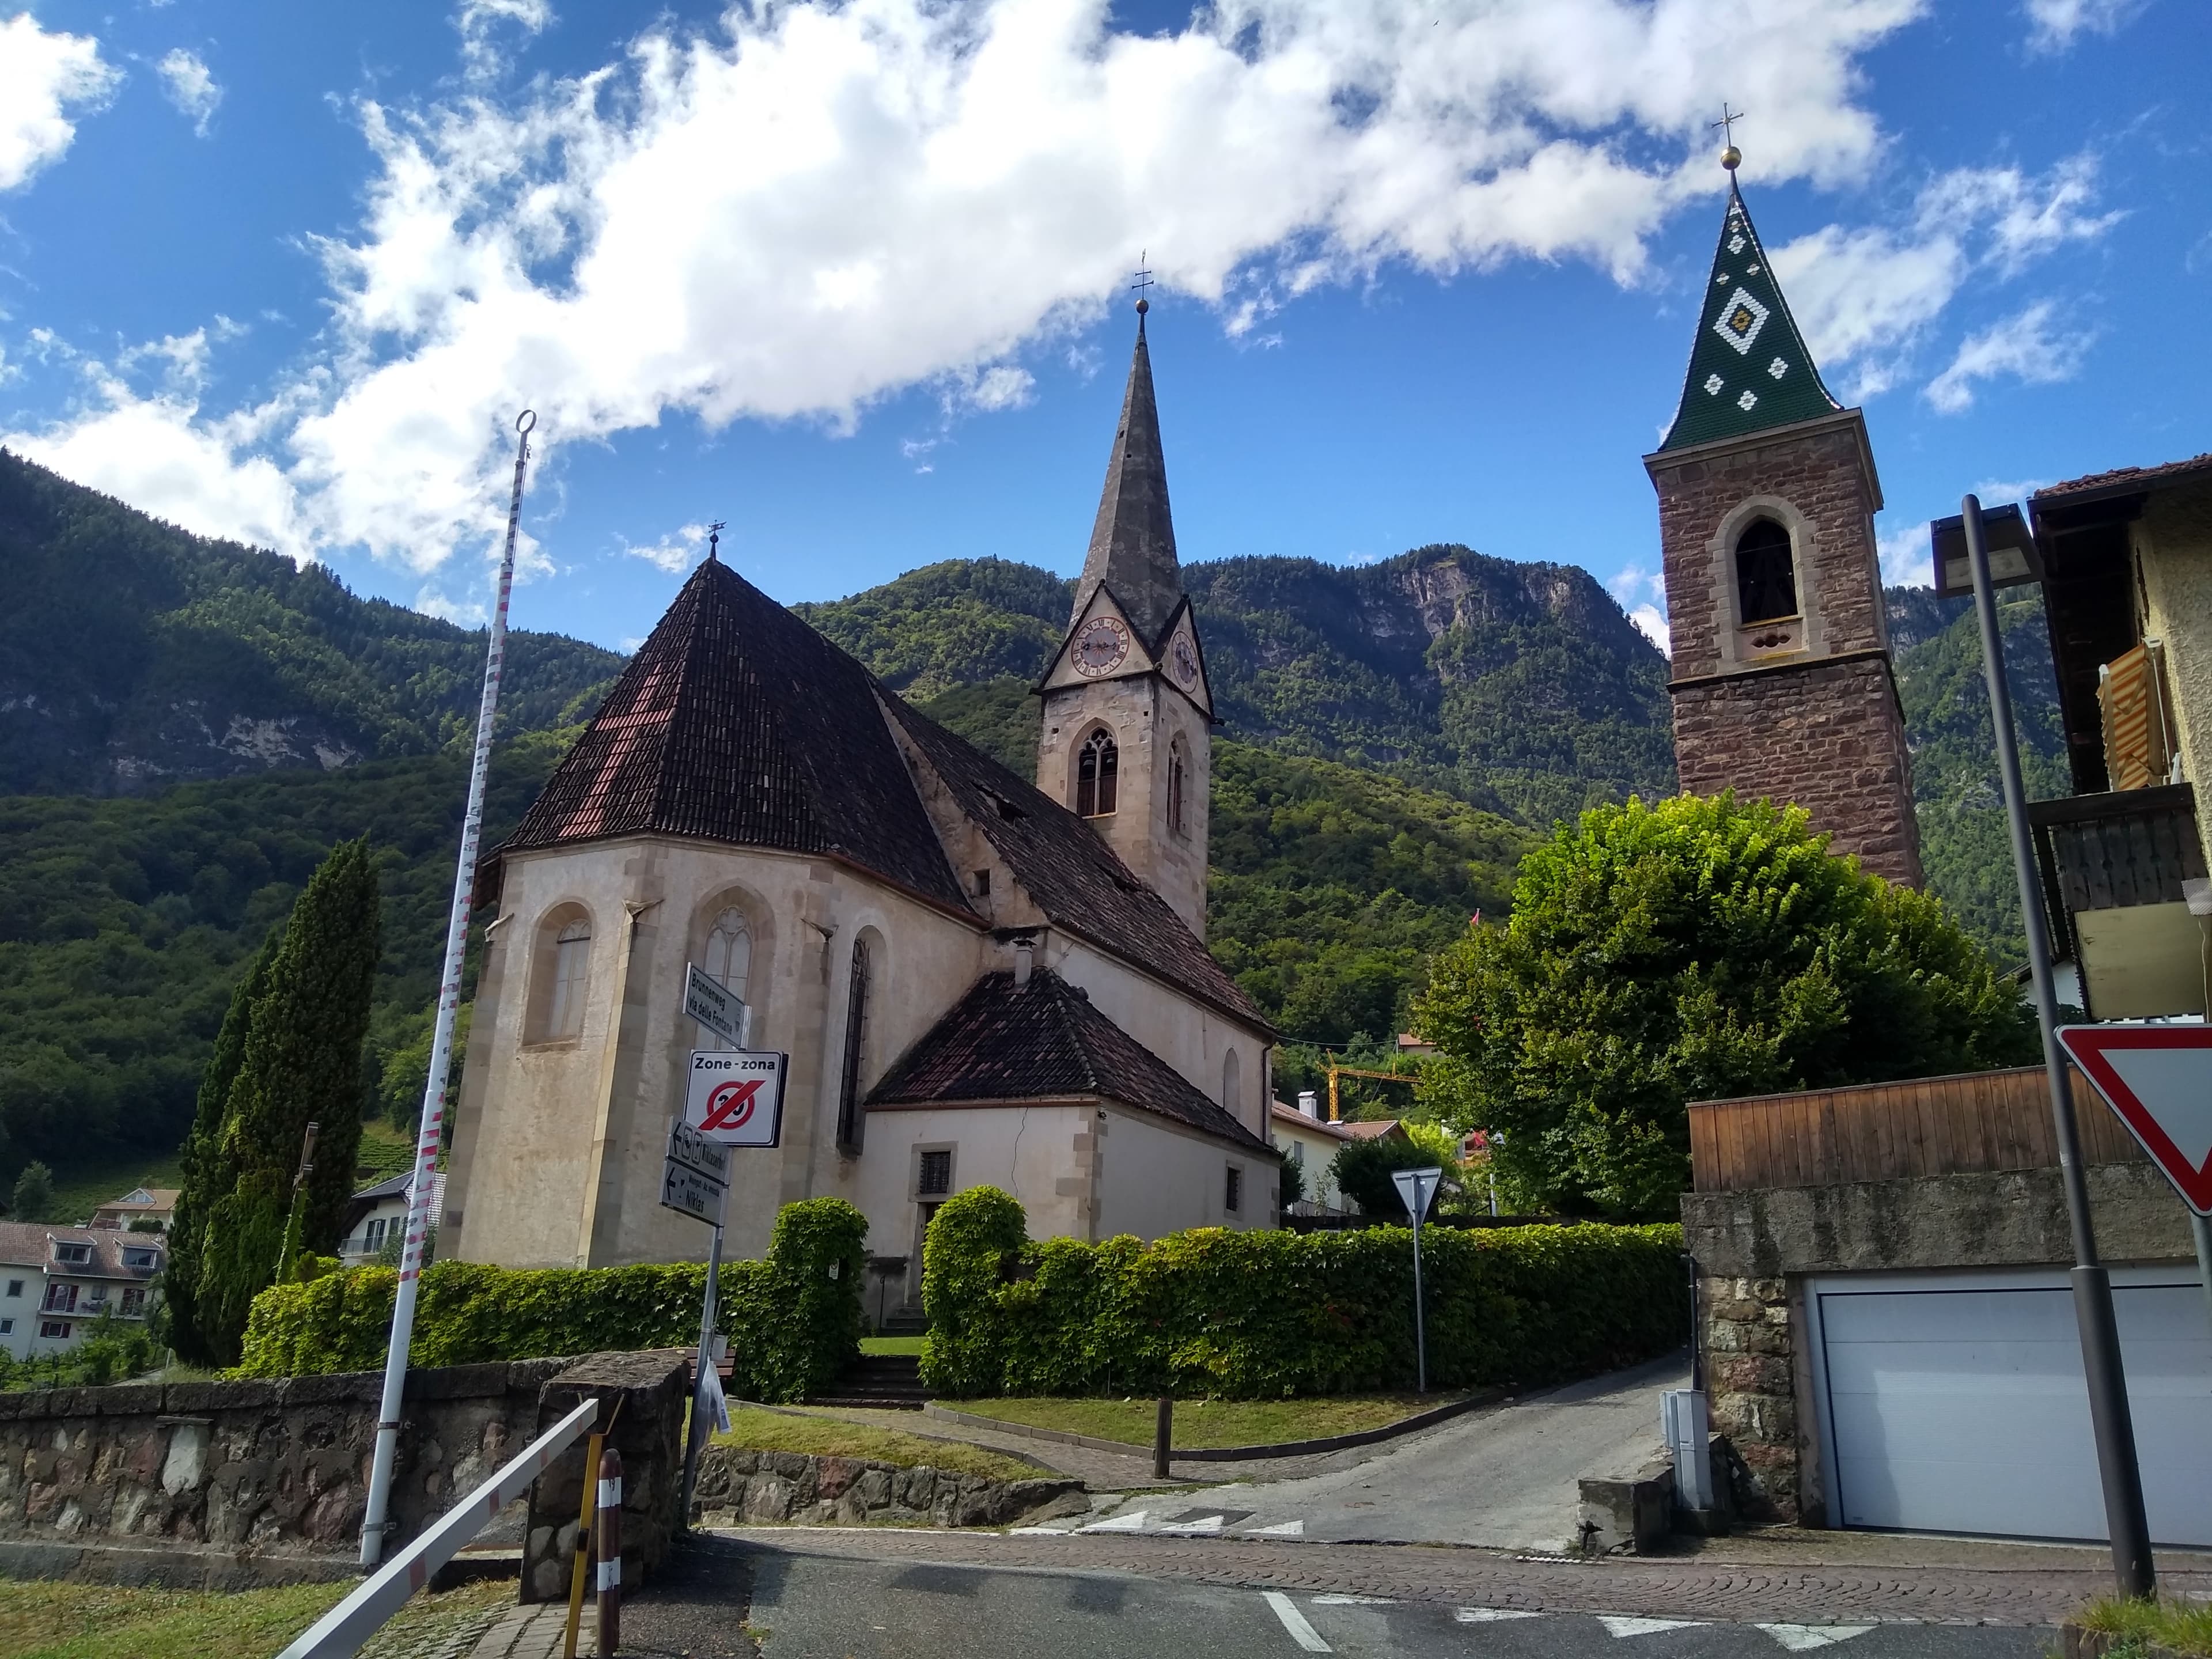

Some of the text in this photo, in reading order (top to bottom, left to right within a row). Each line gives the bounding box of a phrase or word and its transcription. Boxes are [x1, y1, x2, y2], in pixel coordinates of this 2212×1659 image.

[691, 972, 726, 1011] Brunnenweg
[689, 995, 733, 1035] via delle Fontane
[695, 1057, 732, 1069] Zone
[741, 1060, 775, 1070] zona
[685, 1189, 704, 1214] Niklas
